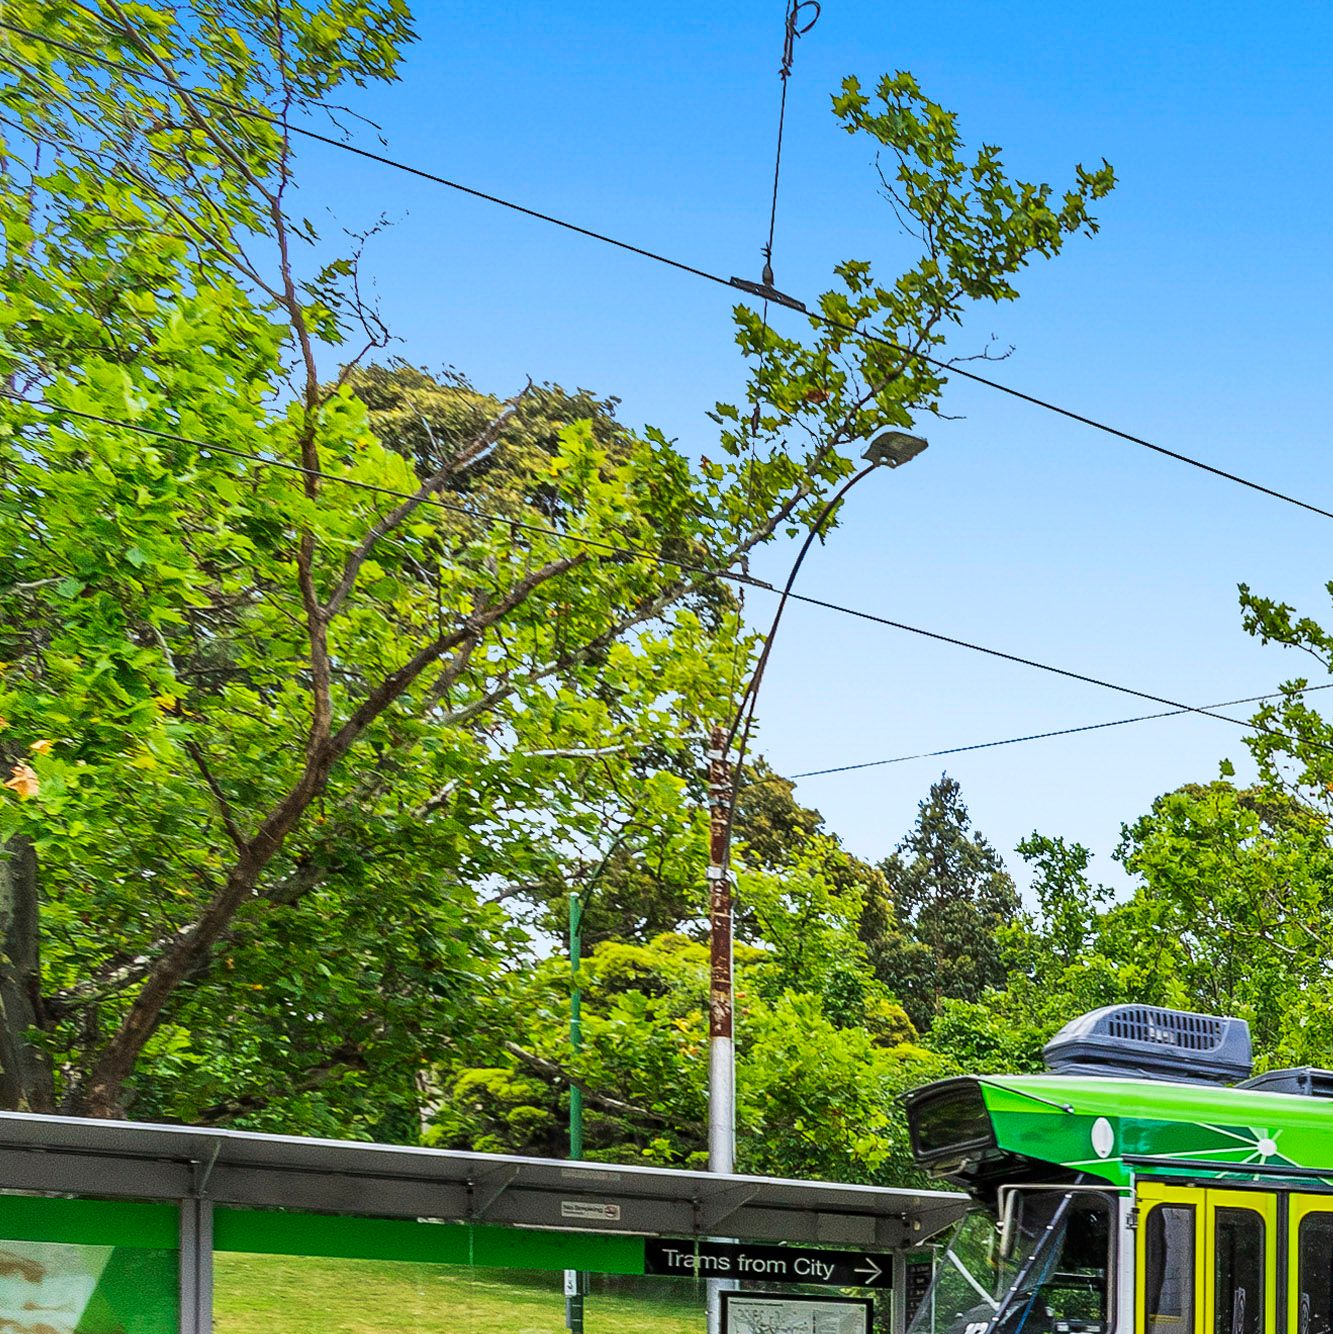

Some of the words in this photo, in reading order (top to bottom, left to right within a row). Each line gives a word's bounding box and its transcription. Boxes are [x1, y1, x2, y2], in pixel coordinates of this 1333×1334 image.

[662, 1248, 730, 1271] Trams
[737, 1253, 787, 1274] from
[793, 1257, 835, 1280] City
